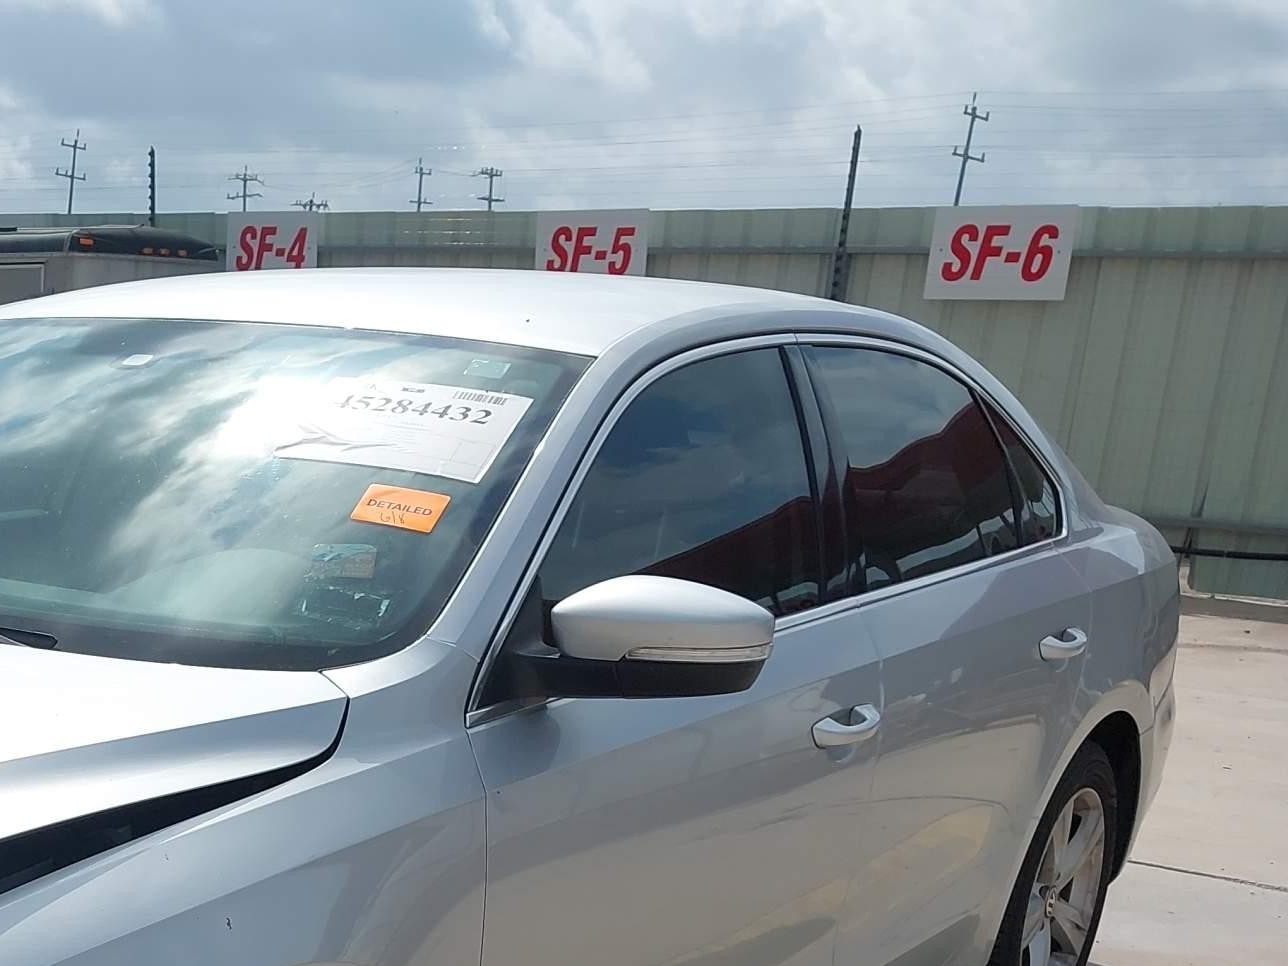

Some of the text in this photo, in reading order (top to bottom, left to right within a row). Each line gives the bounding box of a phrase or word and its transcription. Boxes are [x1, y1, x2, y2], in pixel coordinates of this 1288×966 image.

[235, 225, 308, 271] SF-4
[545, 226, 636, 275] SF-5
[941, 223, 1060, 282] SF-6
[334, 393, 493, 425] 45284432
[366, 498, 433, 516] DETAILED
